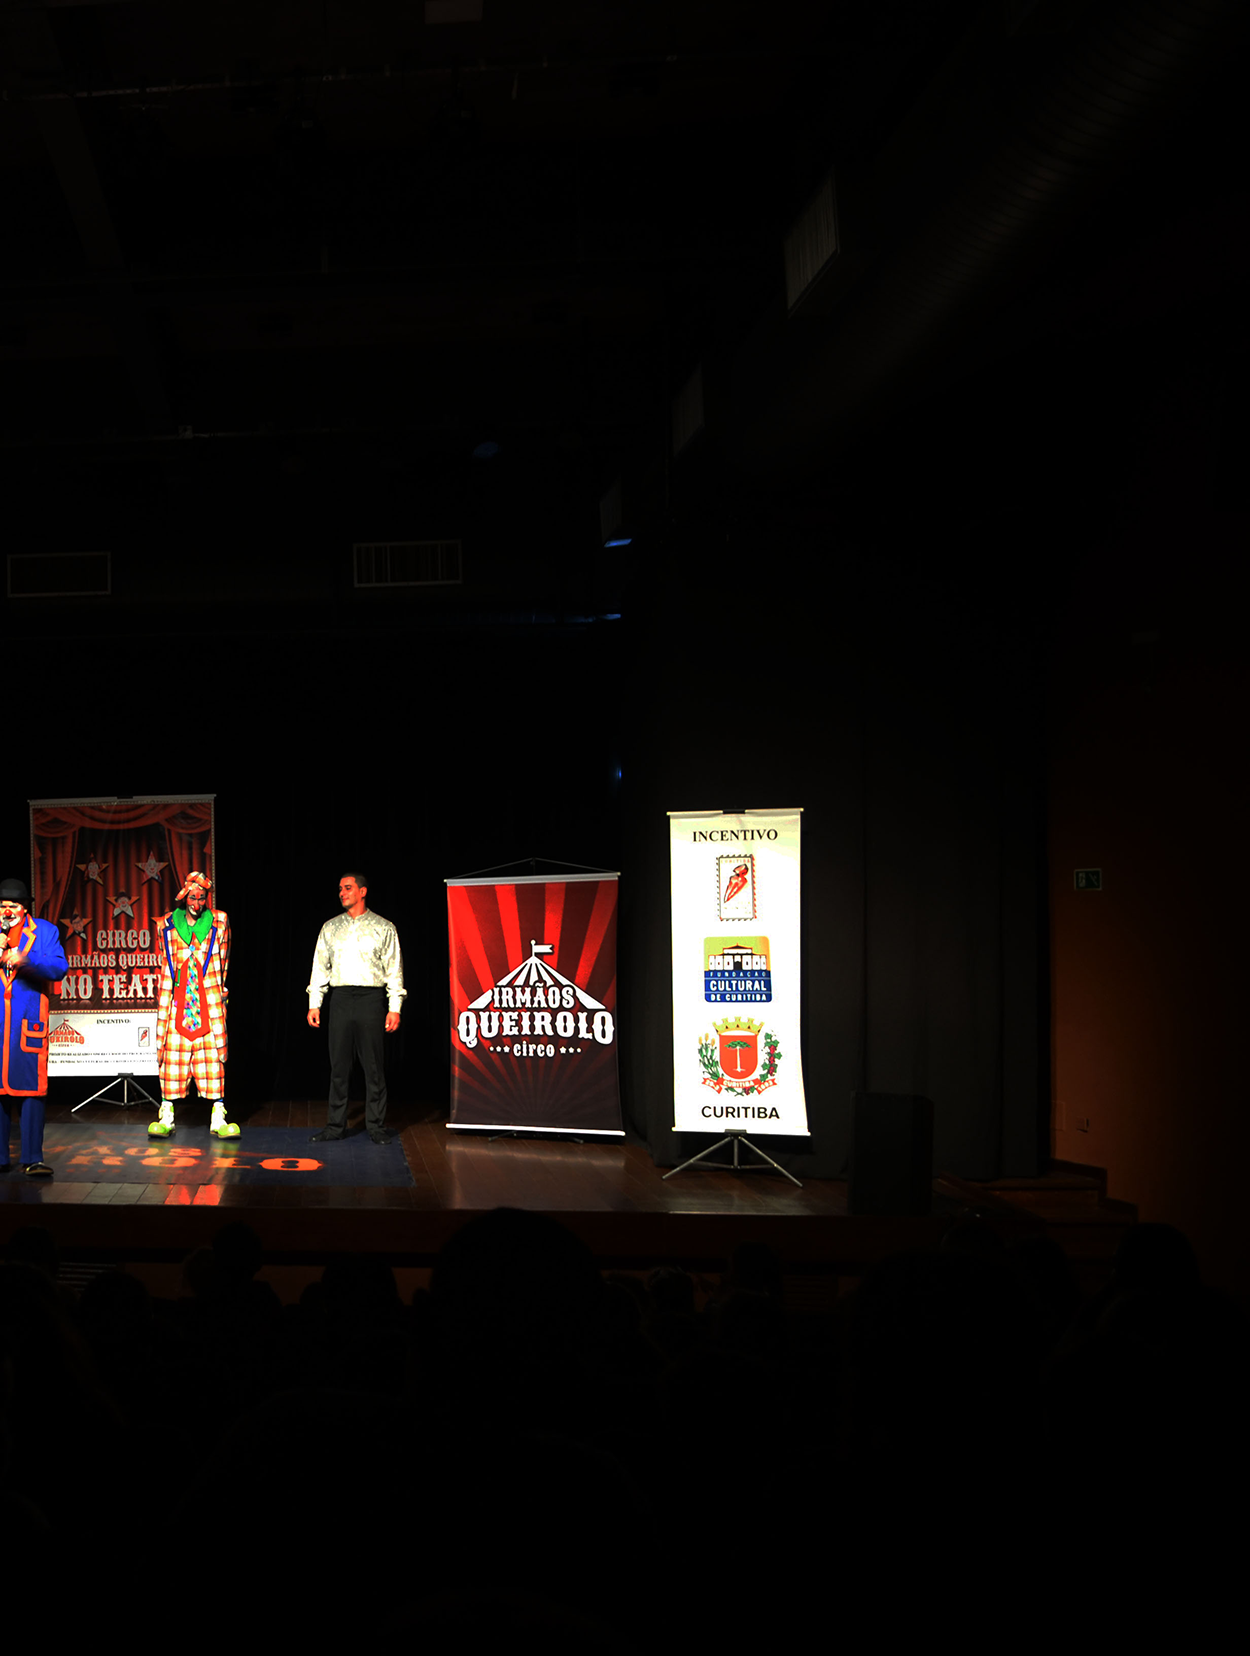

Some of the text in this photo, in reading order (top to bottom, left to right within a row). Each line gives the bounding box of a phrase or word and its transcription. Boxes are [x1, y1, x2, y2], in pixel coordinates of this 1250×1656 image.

[693, 828, 778, 842] INCENTIVO
[96, 929, 151, 949] CIRCO
[68, 951, 116, 967] IRMÃOS
[60, 974, 93, 999] NO
[709, 980, 767, 991] CULTURAL
[493, 982, 575, 1009] IRMÃOS
[710, 993, 767, 1001] DE CURITIBA
[457, 1010, 615, 1048] QUEIROLO
[512, 1040, 555, 1057] circo
[701, 1105, 780, 1119] CURITIBA
